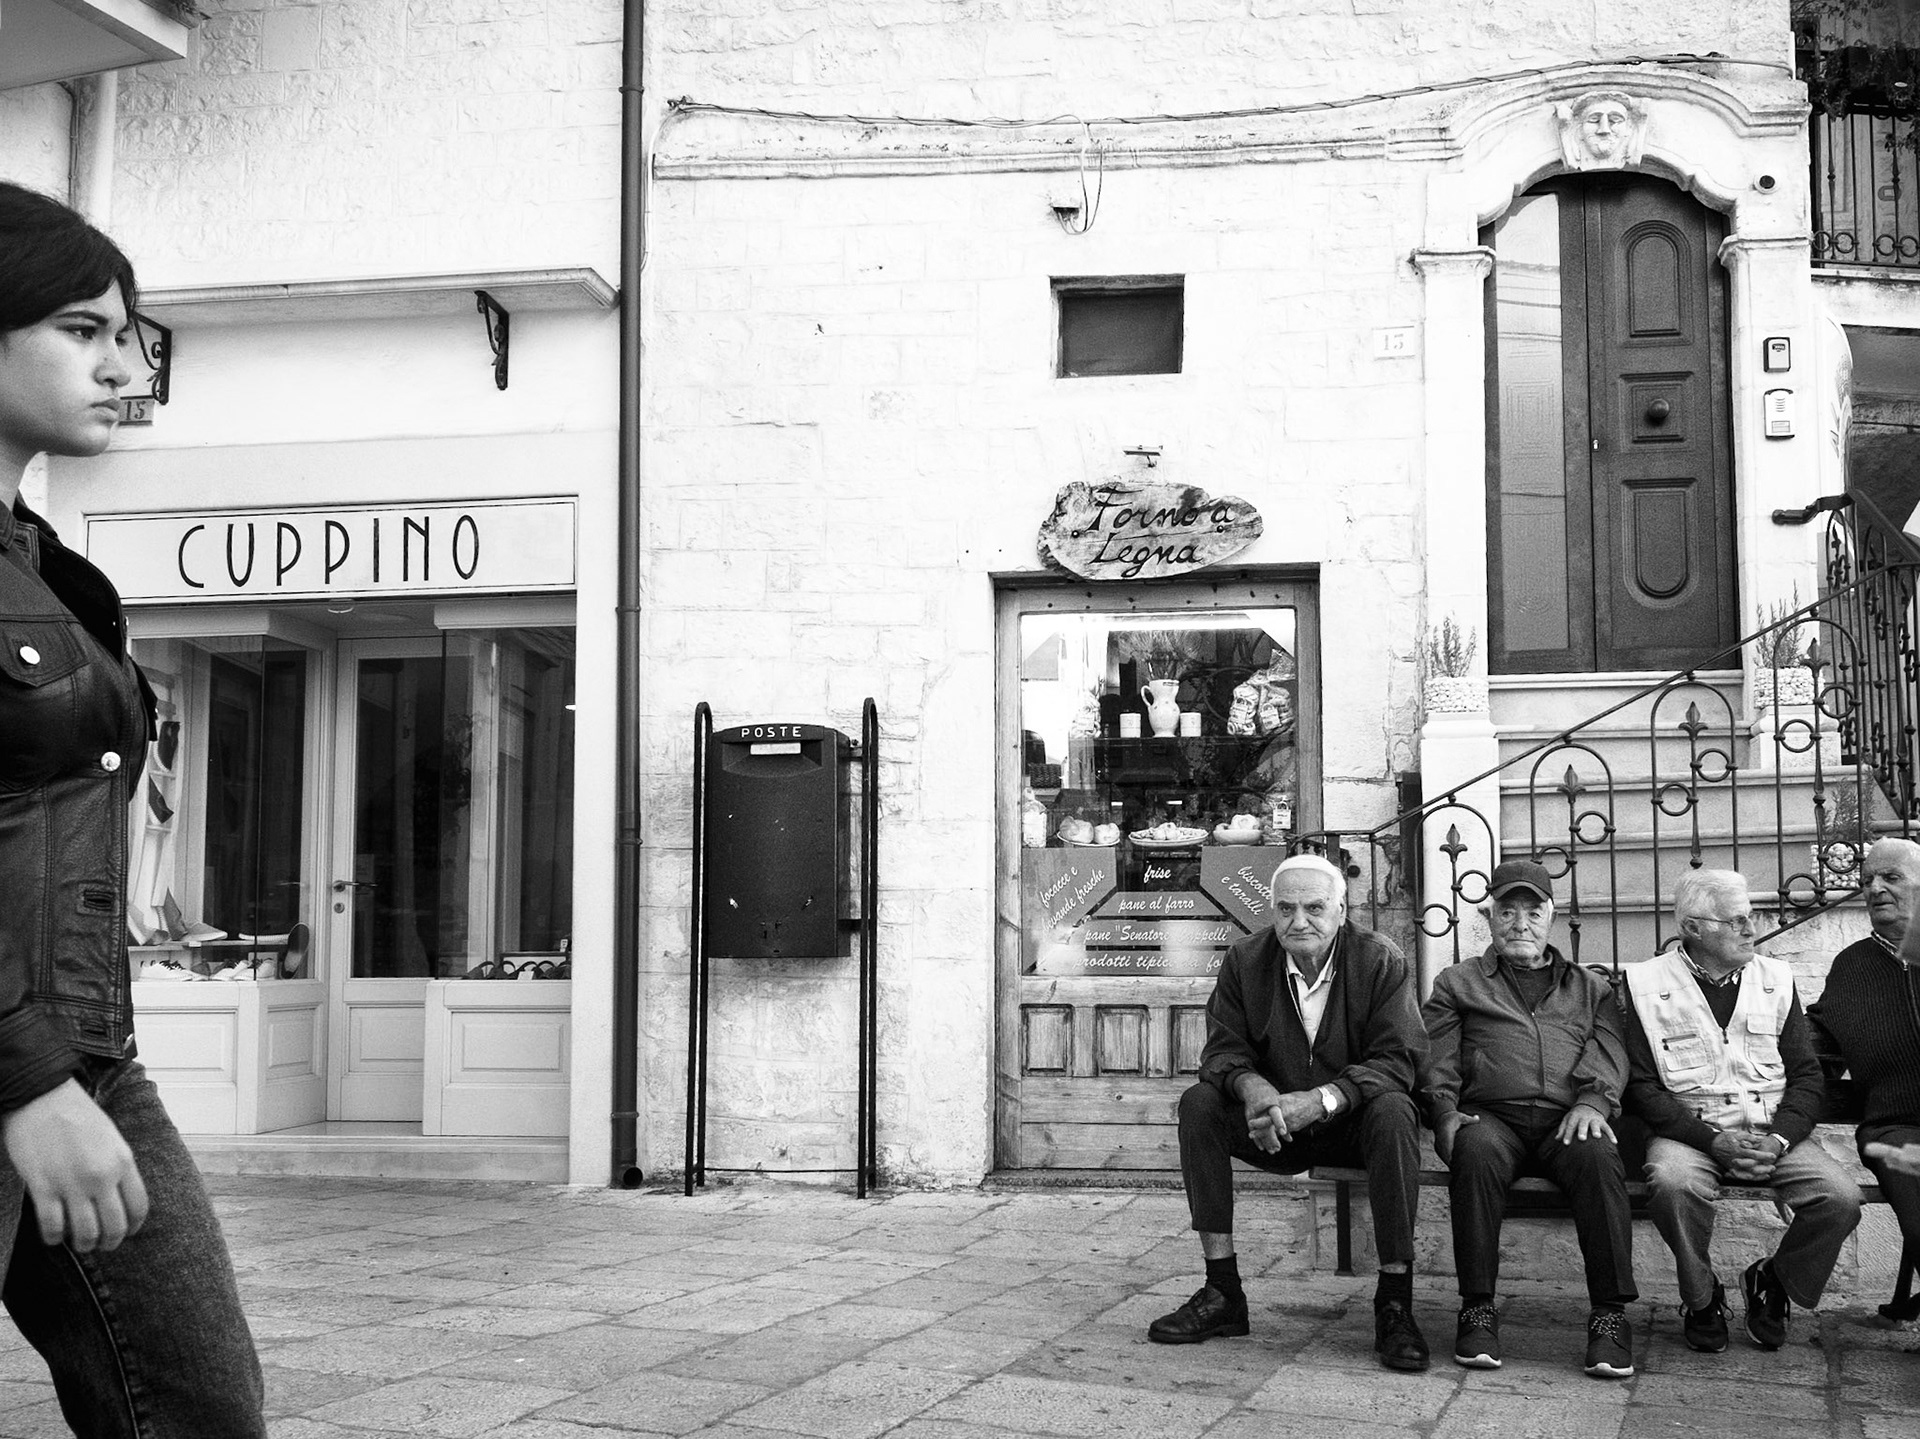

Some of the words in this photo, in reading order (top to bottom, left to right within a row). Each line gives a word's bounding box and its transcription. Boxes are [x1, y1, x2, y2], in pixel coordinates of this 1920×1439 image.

[1384, 333, 1404, 351] 15
[125, 400, 146, 420] 15
[1088, 487, 1197, 530] Forno
[1211, 502, 1235, 523] a
[178, 514, 479, 588] CUPPINO
[1090, 532, 1203, 578] Legna
[741, 726, 801, 738] POSTE
[1040, 873, 1071, 908] focacce
[1070, 866, 1078, 876] e
[1074, 868, 1105, 904] fresche
[1144, 864, 1171, 883] frise
[1118, 899, 1146, 913] pane
[1149, 895, 1162, 909] al
[1164, 895, 1195, 914] farro
[1221, 876, 1230, 884] e
[1228, 882, 1264, 915] taralli
[1083, 929, 1112, 944] pane
